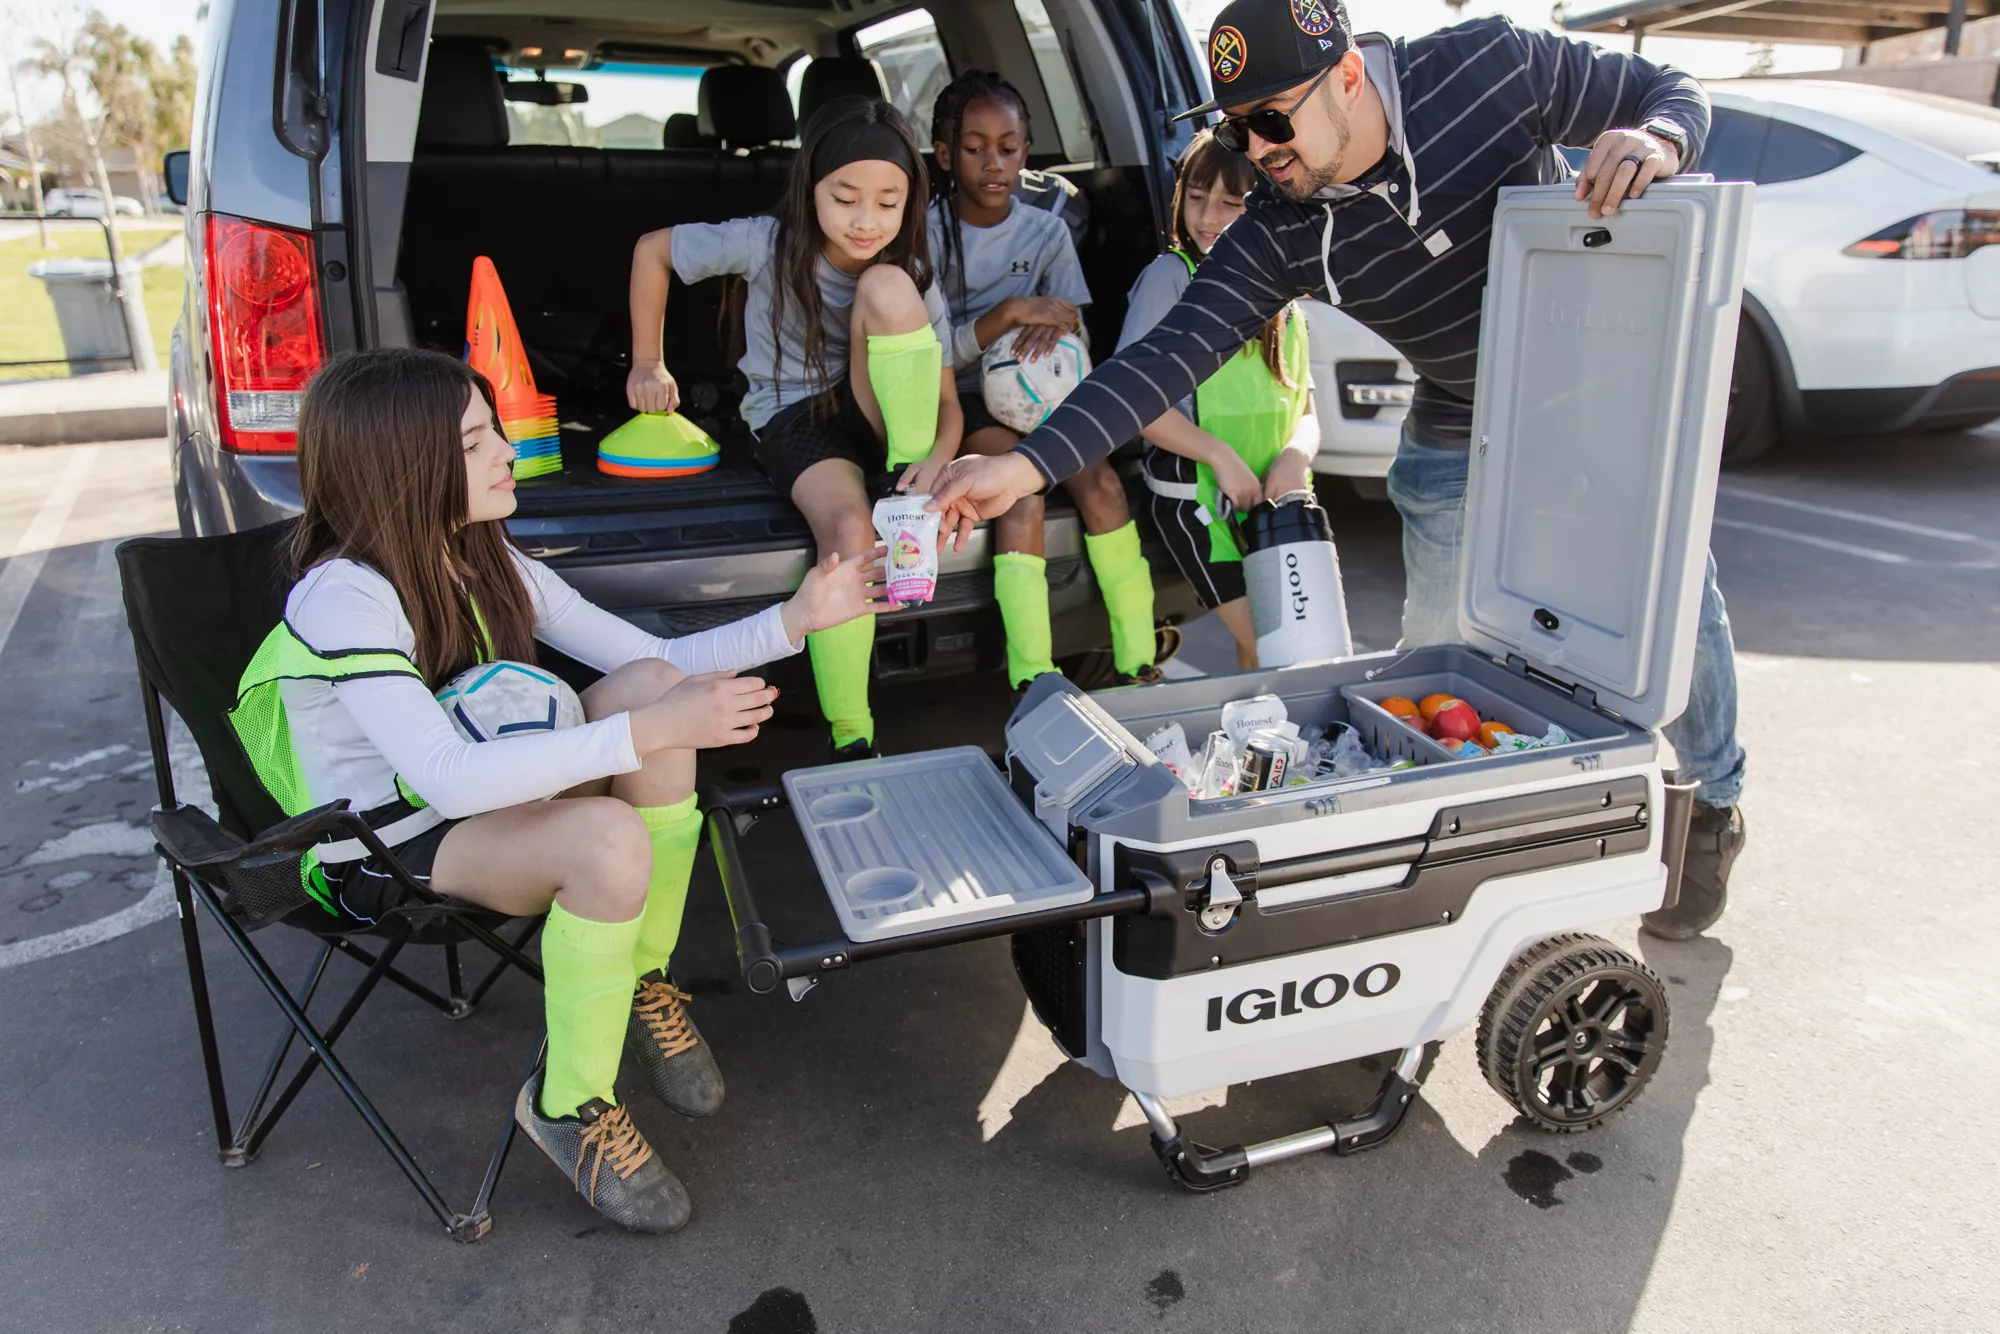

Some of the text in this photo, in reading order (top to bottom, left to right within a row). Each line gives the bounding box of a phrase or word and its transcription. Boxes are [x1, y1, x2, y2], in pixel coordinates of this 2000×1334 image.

[1300, 17, 1331, 32] NUGGET
[887, 512, 927, 524] Honest
[893, 572, 925, 580] ORGANIC
[1286, 553, 1309, 620] IGLOO
[1236, 716, 1273, 729] Honest
[1153, 740, 1174, 756] nest
[1206, 962, 1401, 1032] IGLOO
